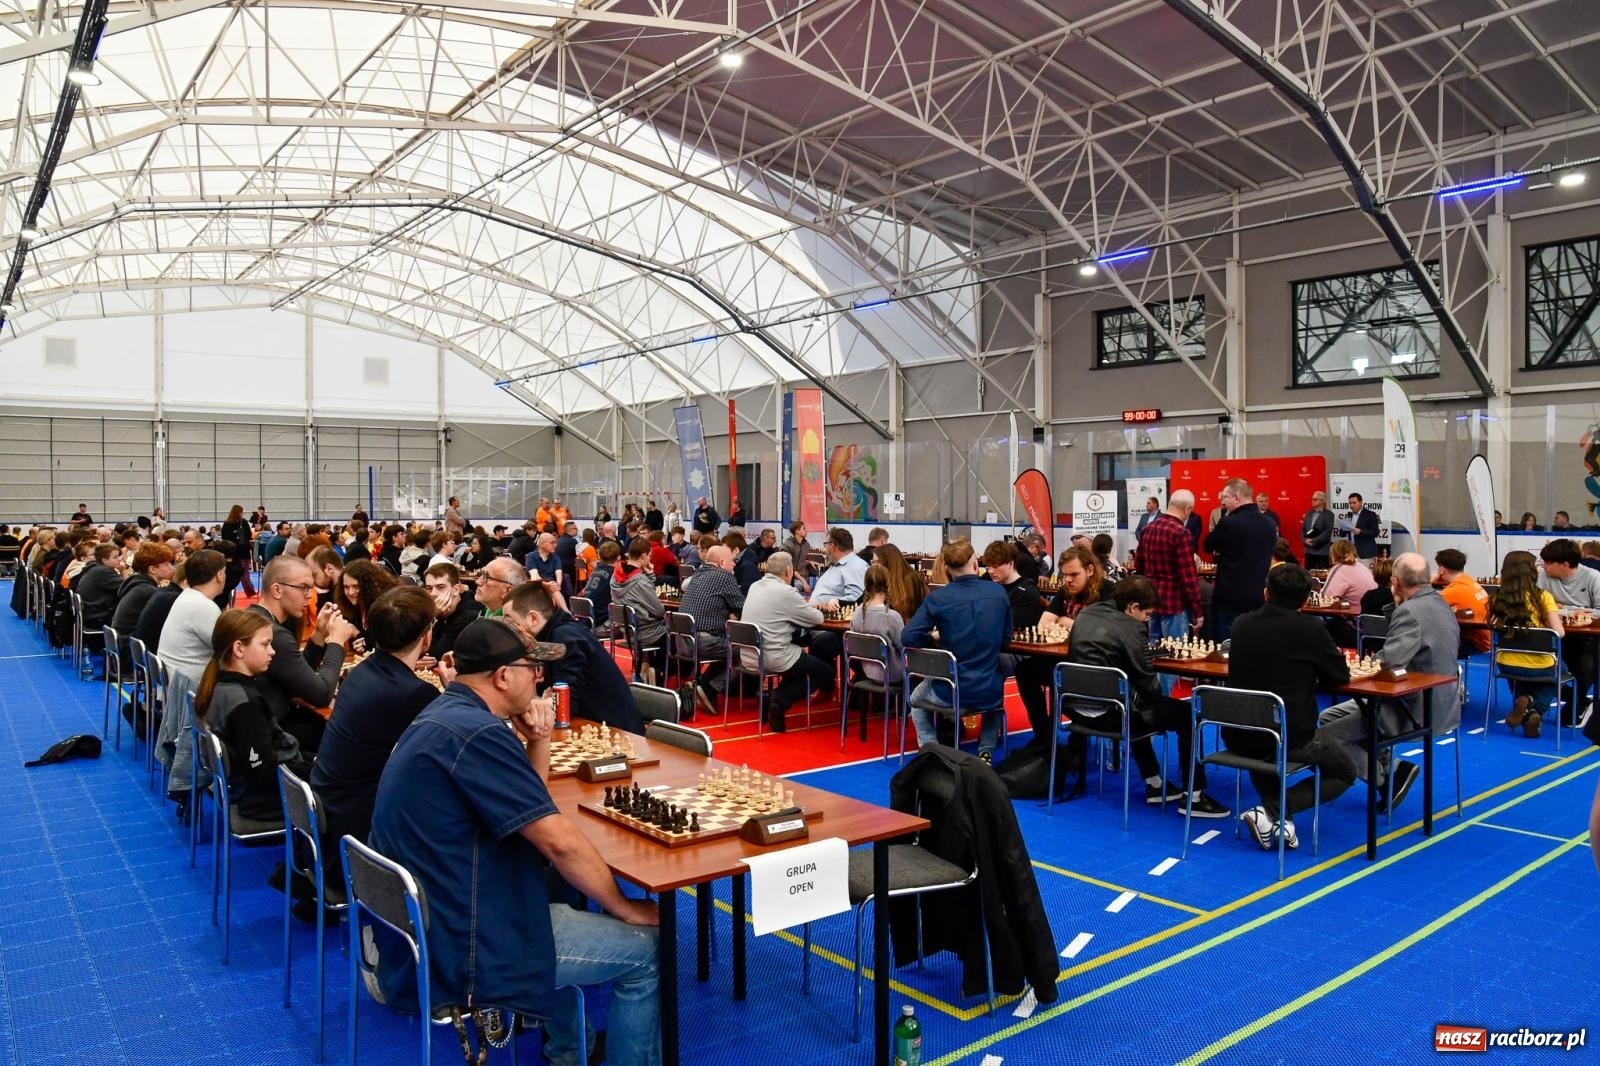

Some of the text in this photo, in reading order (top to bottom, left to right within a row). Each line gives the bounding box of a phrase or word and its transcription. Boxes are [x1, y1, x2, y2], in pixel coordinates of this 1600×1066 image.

[1332, 502, 1349, 510] KLUB
[786, 862, 817, 878] GRUPA
[789, 881, 814, 895] OPEN
